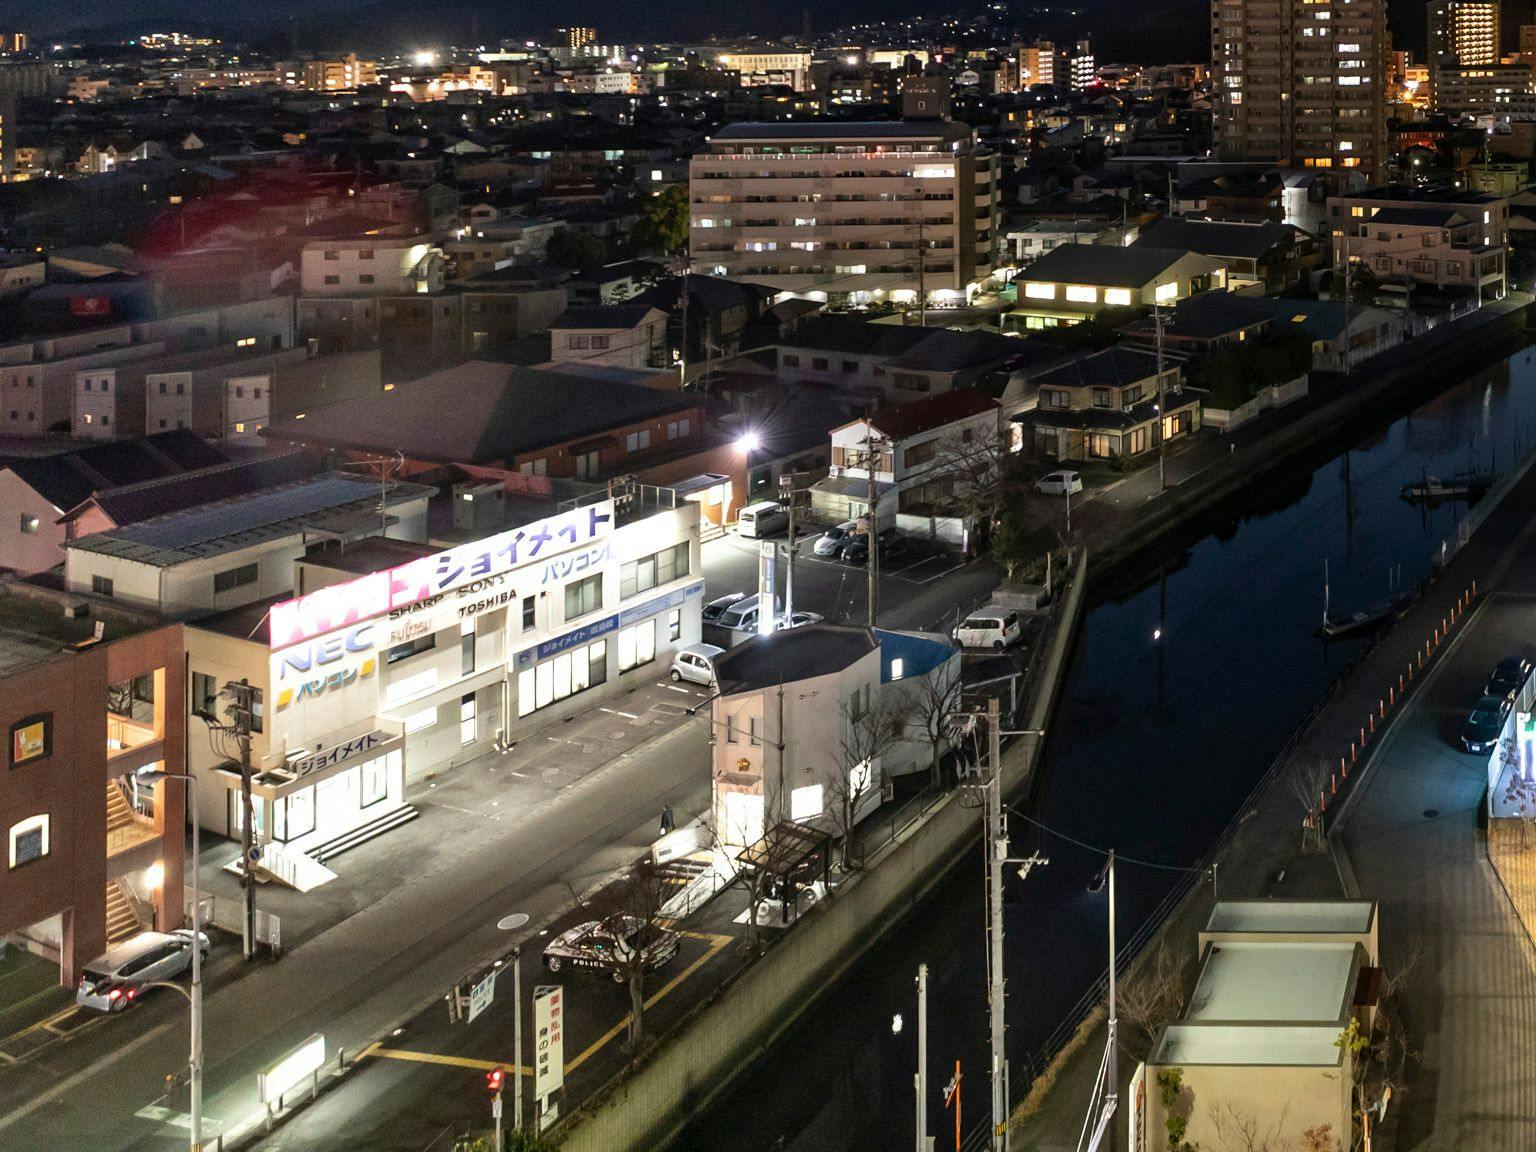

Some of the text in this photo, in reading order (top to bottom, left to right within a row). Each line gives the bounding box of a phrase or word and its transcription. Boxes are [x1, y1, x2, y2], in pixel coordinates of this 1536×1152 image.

[456, 571, 511, 600] SONY
[389, 593, 445, 621] SHARP
[458, 589, 517, 618] TOSHIBA
[281, 624, 375, 681] NEC
[296, 668, 359, 703] パソコン
[301, 734, 378, 776] ジョイメイト
